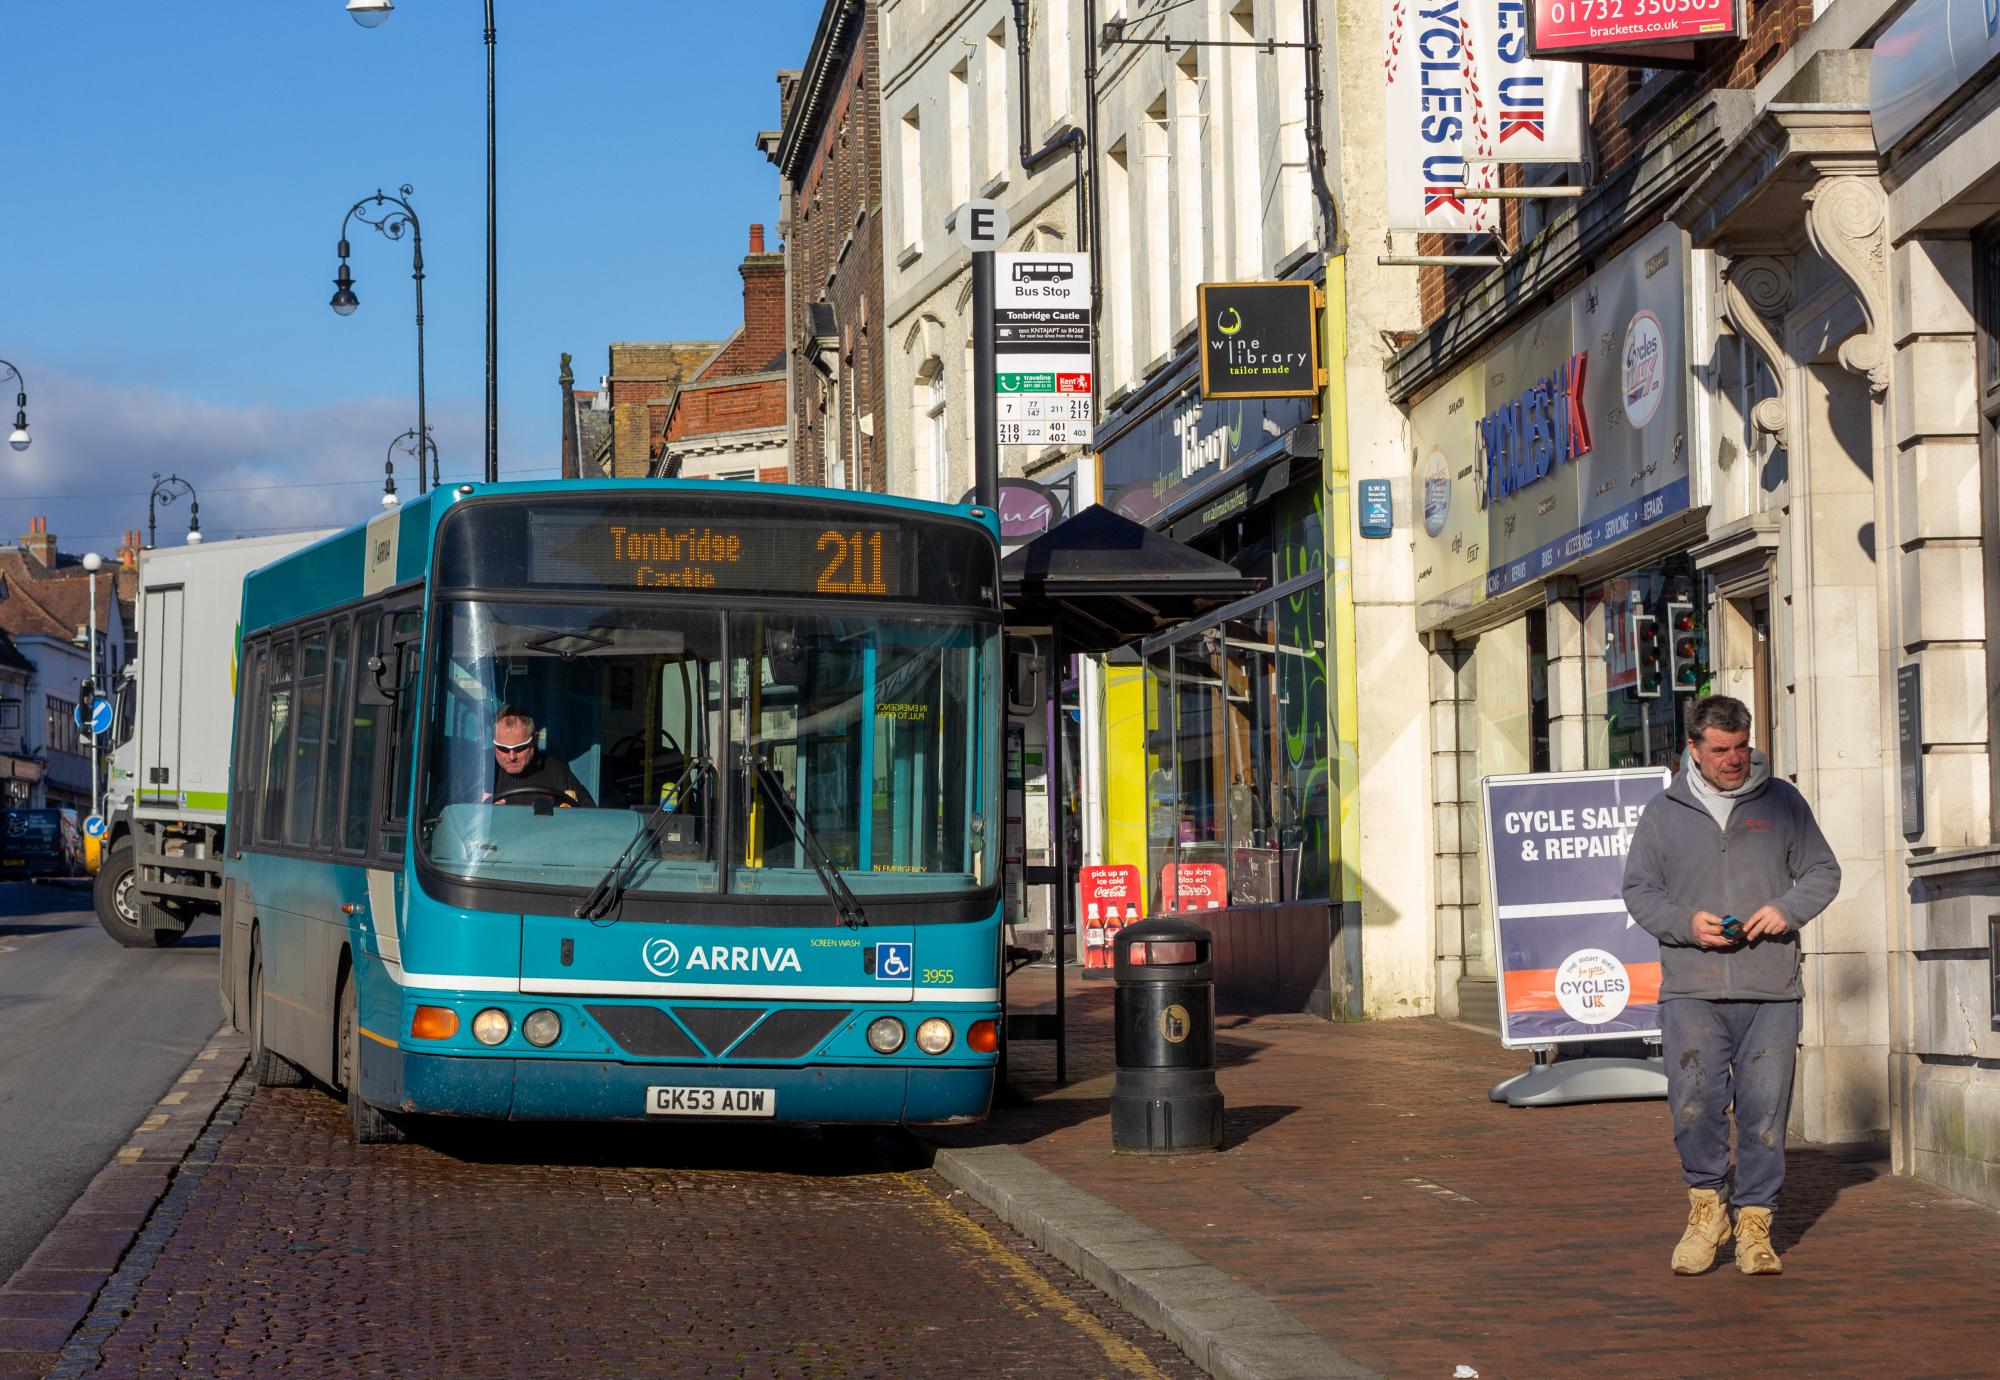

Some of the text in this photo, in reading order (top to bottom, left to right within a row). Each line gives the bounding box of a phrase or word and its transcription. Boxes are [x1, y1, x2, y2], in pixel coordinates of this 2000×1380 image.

[1551, 0, 1624, 23] 01732
[1590, 19, 1679, 37] bracketts.co.uk
[1419, 0, 1466, 216] YCLES UK
[1498, 77, 1544, 144] UK
[971, 208, 995, 240] E
[1015, 286, 1071, 298] Bus Stop
[1006, 311, 1080, 321] Tonbridge Castle
[1211, 336, 1260, 350] wine
[1229, 348, 1307, 367] library
[1230, 364, 1290, 375] tailor made
[1060, 377, 1077, 385] Kent
[1006, 404, 1013, 413] 7
[1070, 400, 1089, 410] 216
[1070, 410, 1089, 419] 217
[999, 424, 1020, 433] 218
[1049, 422, 1065, 431] 401
[999, 433, 1020, 443] 219
[1048, 434, 1066, 442] 402
[1541, 495, 1664, 568] BIKES ACCESSORIES SERVICING REPAIRS
[610, 527, 741, 562] Tonbridge
[816, 530, 887, 593] 211
[637, 566, 716, 588] Castle
[1505, 809, 1575, 834] CYCLE
[1521, 839, 1540, 861] &
[1091, 870, 1107, 878] pick
[810, 939, 861, 948] SCREEN WASH
[685, 945, 802, 972] ARRIVA
[1566, 956, 1616, 973] THE RIGHT BIKE
[922, 969, 954, 984] 3955
[1560, 978, 1625, 995] CYCLES
[1582, 994, 1606, 1008] UK
[656, 1088, 765, 1111] GK53 AOW
